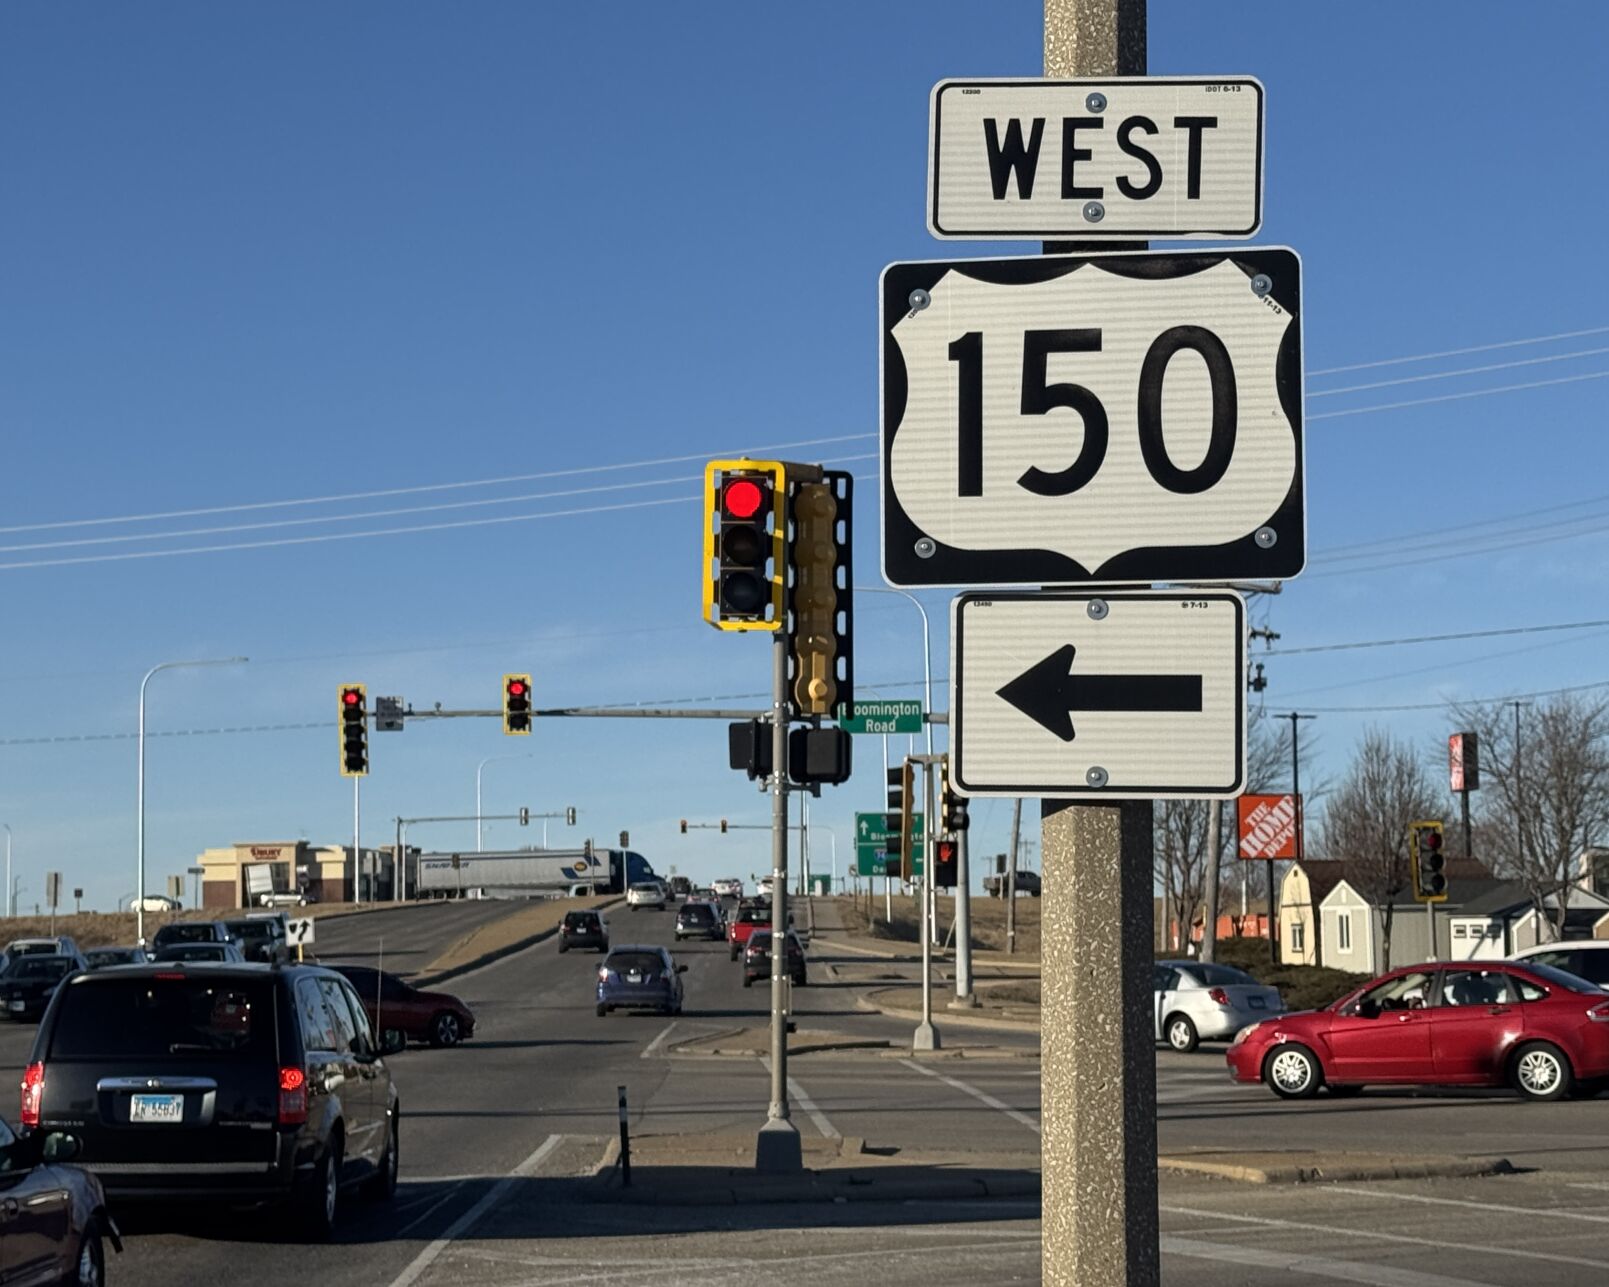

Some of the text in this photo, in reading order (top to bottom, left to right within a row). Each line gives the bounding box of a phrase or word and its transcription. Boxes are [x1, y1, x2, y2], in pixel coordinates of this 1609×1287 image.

[983, 116, 1218, 200] WEST
[948, 325, 1238, 497] 150
[866, 719, 896, 732] Road
[1244, 801, 1271, 827] THE
